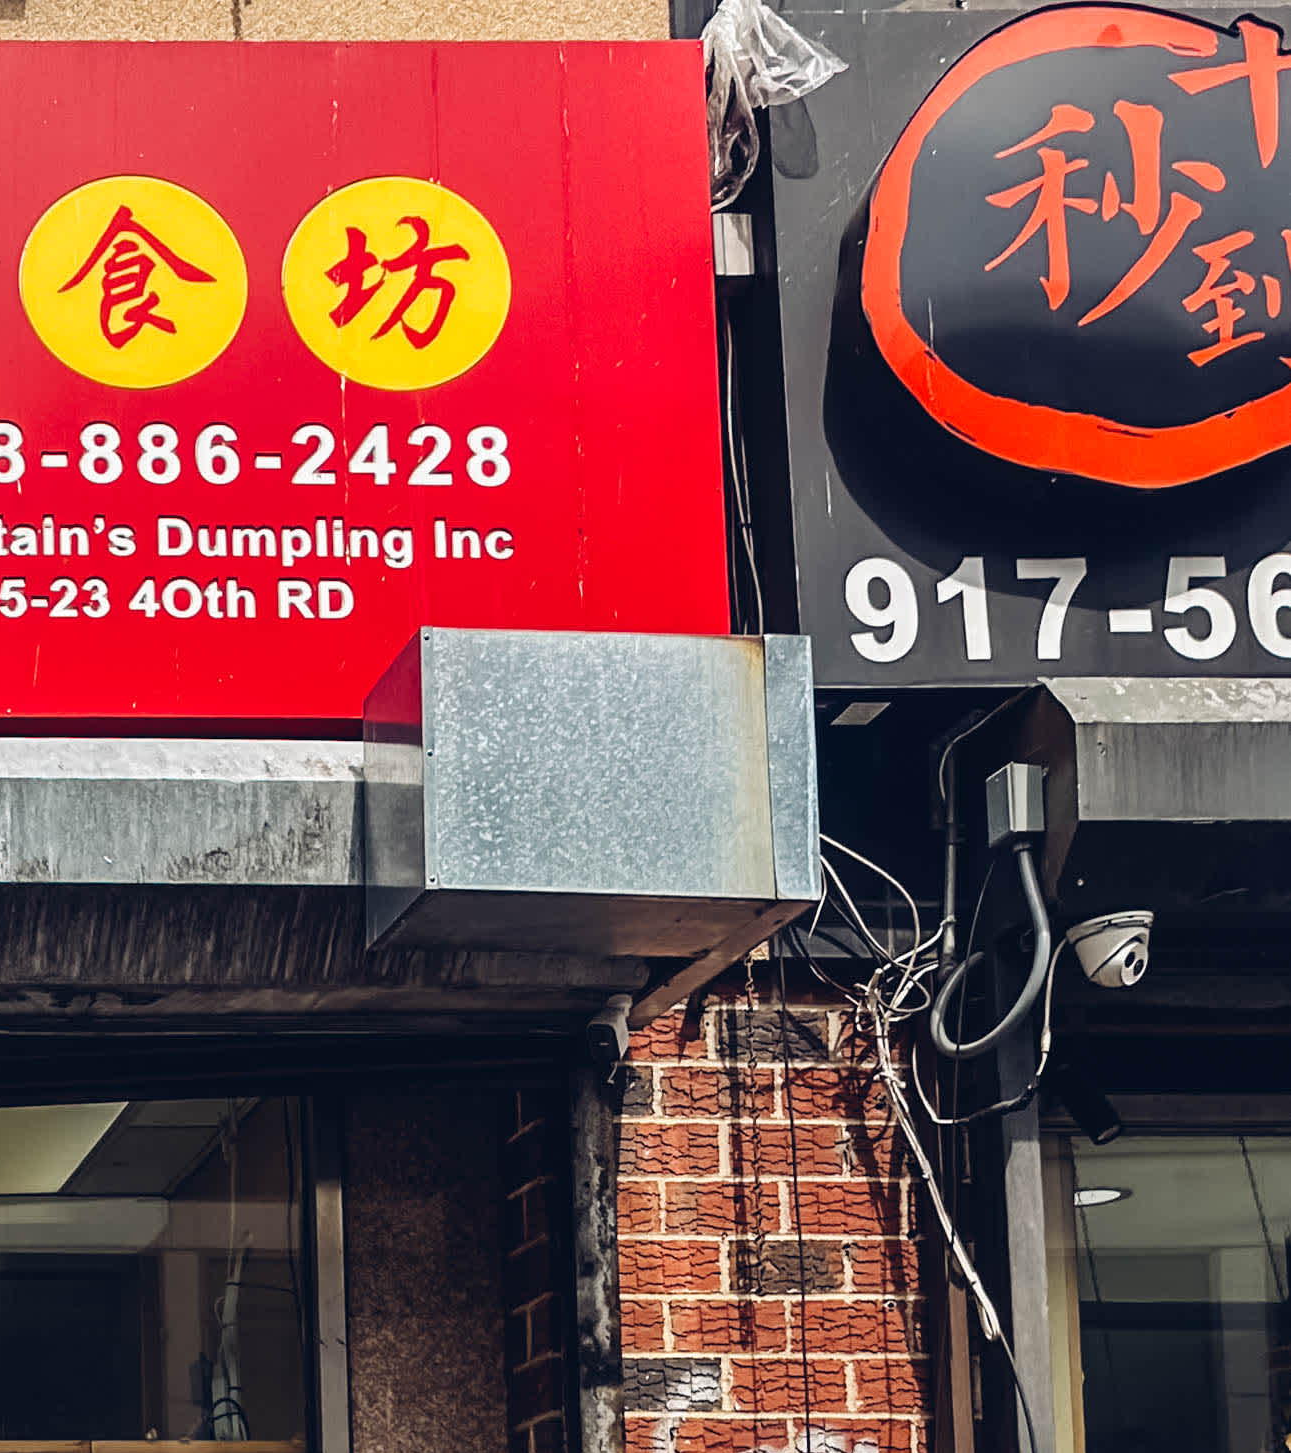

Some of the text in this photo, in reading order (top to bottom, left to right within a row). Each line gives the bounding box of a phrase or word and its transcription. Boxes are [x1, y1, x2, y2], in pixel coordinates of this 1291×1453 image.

[157, 518, 414, 569] Dumpling
[434, 520, 515, 560] Inc
[278, 580, 355, 620] RD
[844, 557, 1291, 663] 917-56
